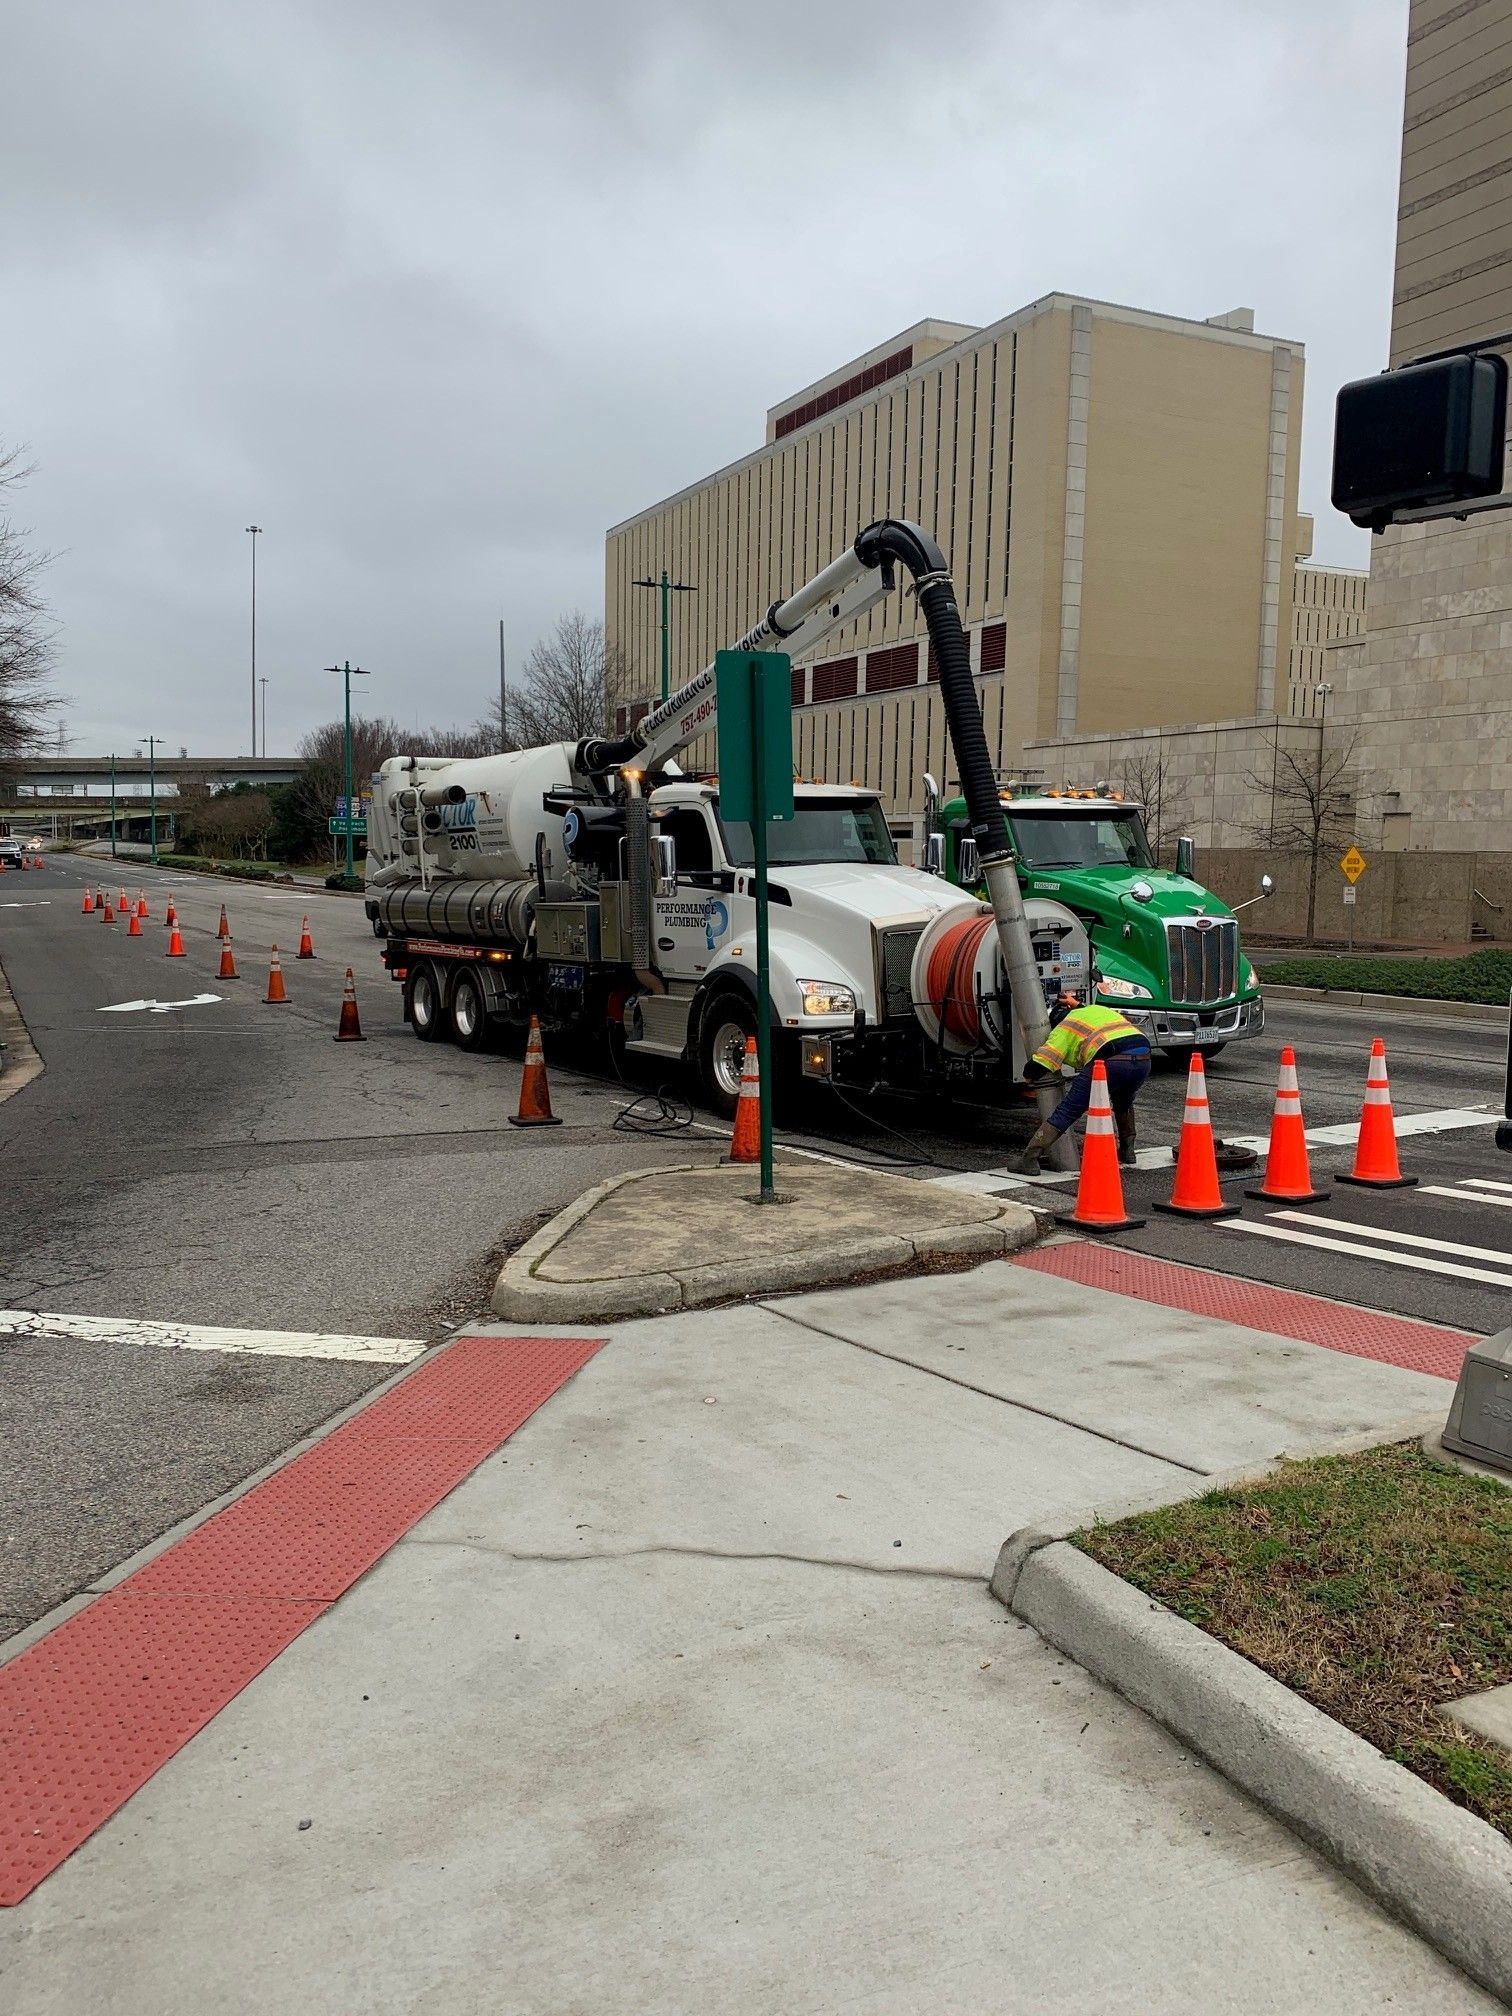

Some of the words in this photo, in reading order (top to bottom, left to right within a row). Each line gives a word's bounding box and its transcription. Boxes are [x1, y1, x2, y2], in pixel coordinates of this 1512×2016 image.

[644, 672, 713, 735] PERFORMANCE
[680, 694, 717, 736] 757-490-7
[439, 799, 476, 828] CTOR
[656, 903, 717, 914] PERFORMANCE
[664, 916, 707, 928] PLUMBING
